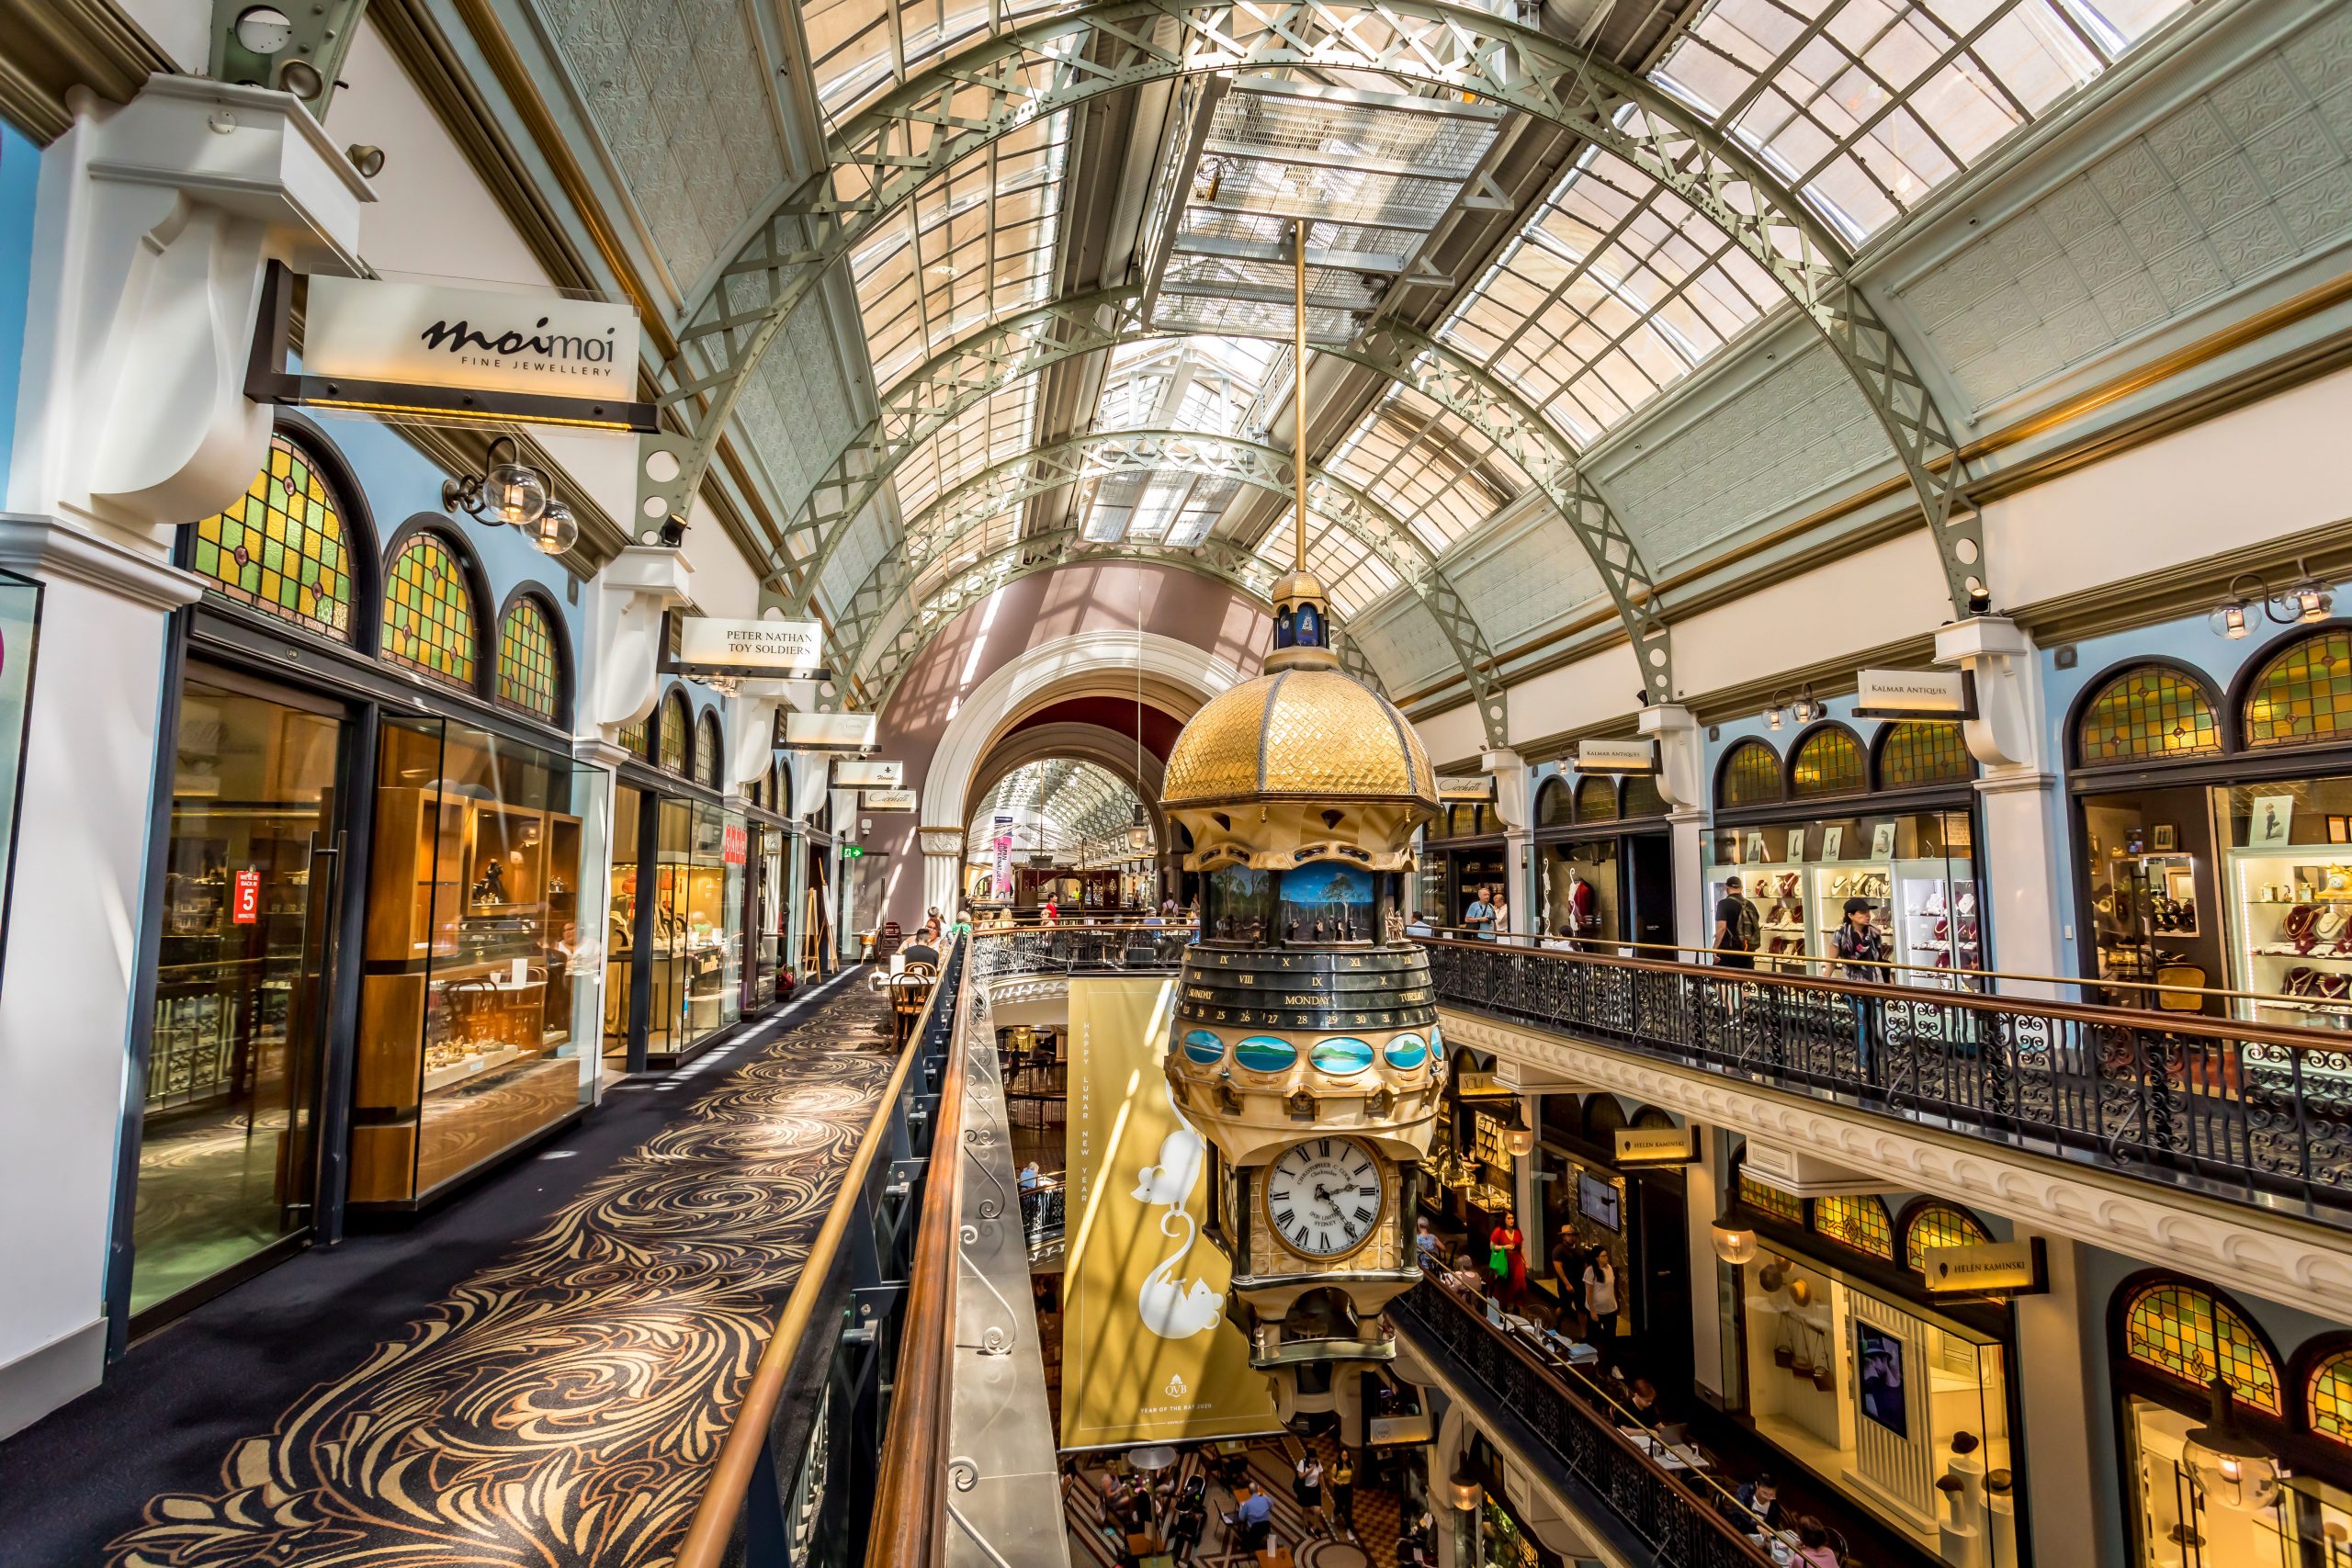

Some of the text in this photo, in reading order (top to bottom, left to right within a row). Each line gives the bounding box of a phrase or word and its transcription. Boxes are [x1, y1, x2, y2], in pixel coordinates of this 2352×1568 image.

[421, 316, 616, 363] moimoi
[461, 355, 611, 377] FINE JEWELLERY
[727, 630, 813, 643] PETER NATHAN
[729, 643, 811, 655] TOY SOLDIERS
[1871, 684, 1947, 695] KALMAR ANTIQUES
[726, 836, 746, 855] SALE
[243, 887, 254, 911] 5
[1219, 955, 1229, 965] IX
[1283, 957, 1291, 967] X
[1350, 957, 1362, 967] XI
[1238, 975, 1254, 985] VIII
[1311, 976, 1323, 987] IX
[1380, 976, 1388, 986] X
[1189, 988, 1424, 1006] SUNDAY MONDAY TUESDAY
[1216, 1010, 1226, 1020] 25
[1240, 1012, 1250, 1022] 26
[1267, 1014, 1279, 1024] 27
[1297, 1015, 1308, 1025] 28
[1327, 1014, 1339, 1025] 29
[1354, 1014, 1367, 1024] 30
[1381, 1013, 1390, 1023] 31
[1080, 1130, 1090, 1156] NEW
[1318, 1140, 1330, 1157] XII
[1296, 1162, 1331, 1185] CHRISTOPHER
[1310, 1168, 1338, 1178] Clockmaker
[1359, 1187, 1376, 1197] III
[1954, 1261, 2025, 1273] HELEN KAMINSKI
[1165, 1384, 1188, 1398] QVB
[1140, 1406, 1158, 1415] YEAR
